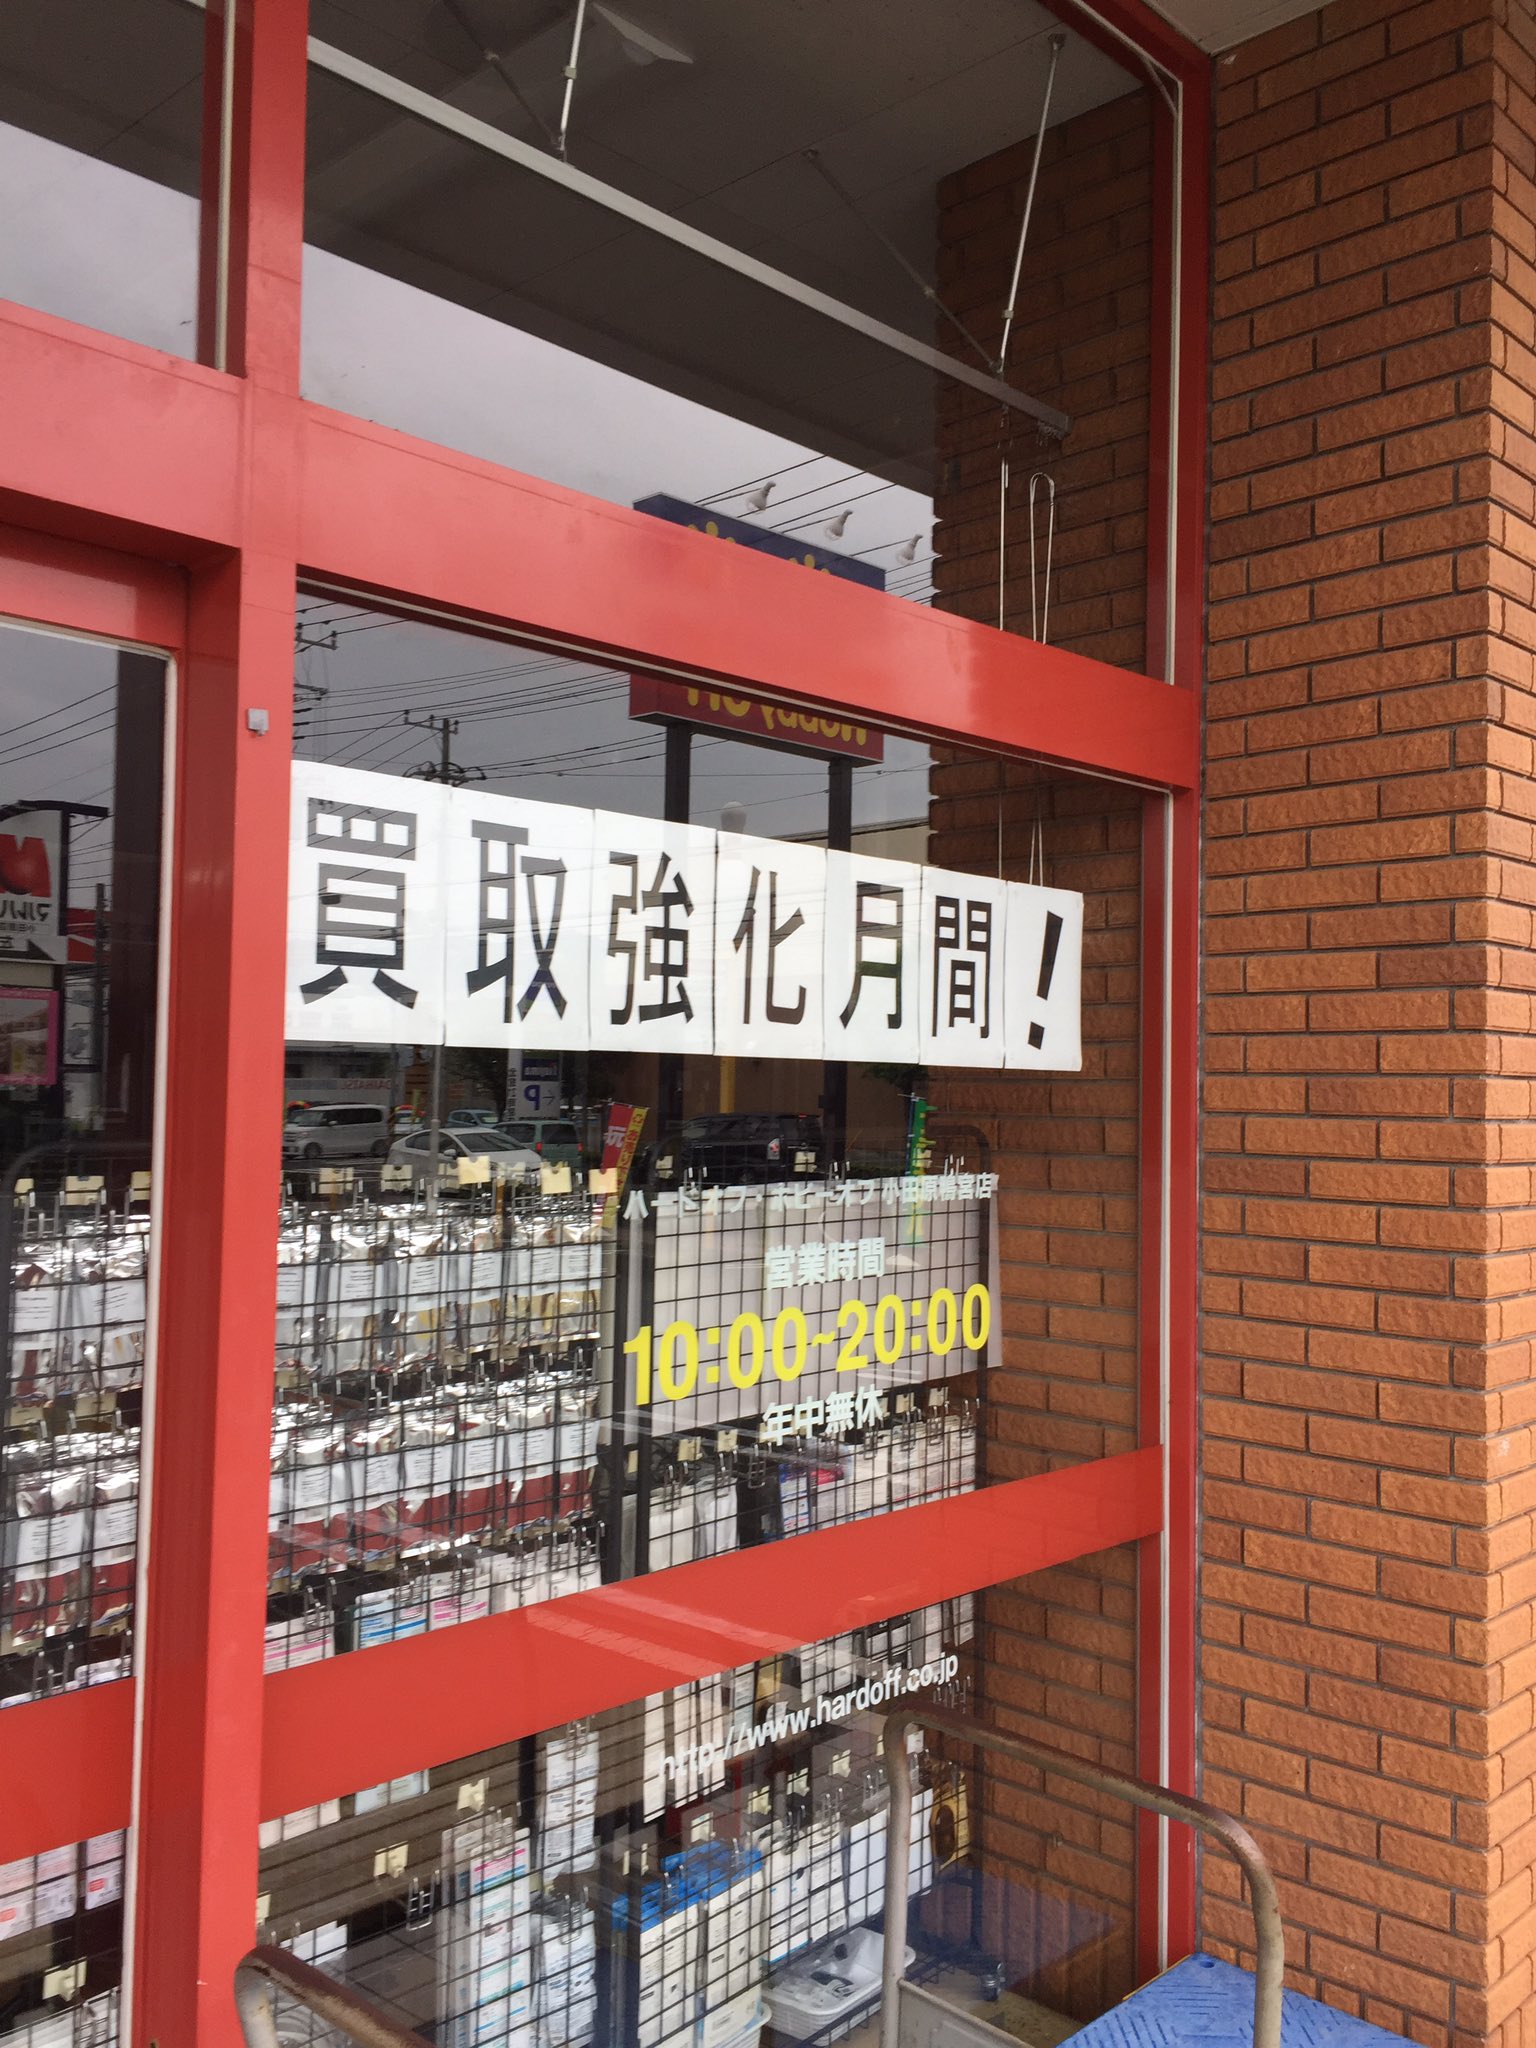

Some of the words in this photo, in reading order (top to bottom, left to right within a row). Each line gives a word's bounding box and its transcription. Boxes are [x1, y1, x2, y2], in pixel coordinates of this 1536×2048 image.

[299, 797, 1063, 1050] 買取強化月間!
[764, 1237, 885, 1290] 営業時間
[762, 1384, 884, 1447] 年中無休
